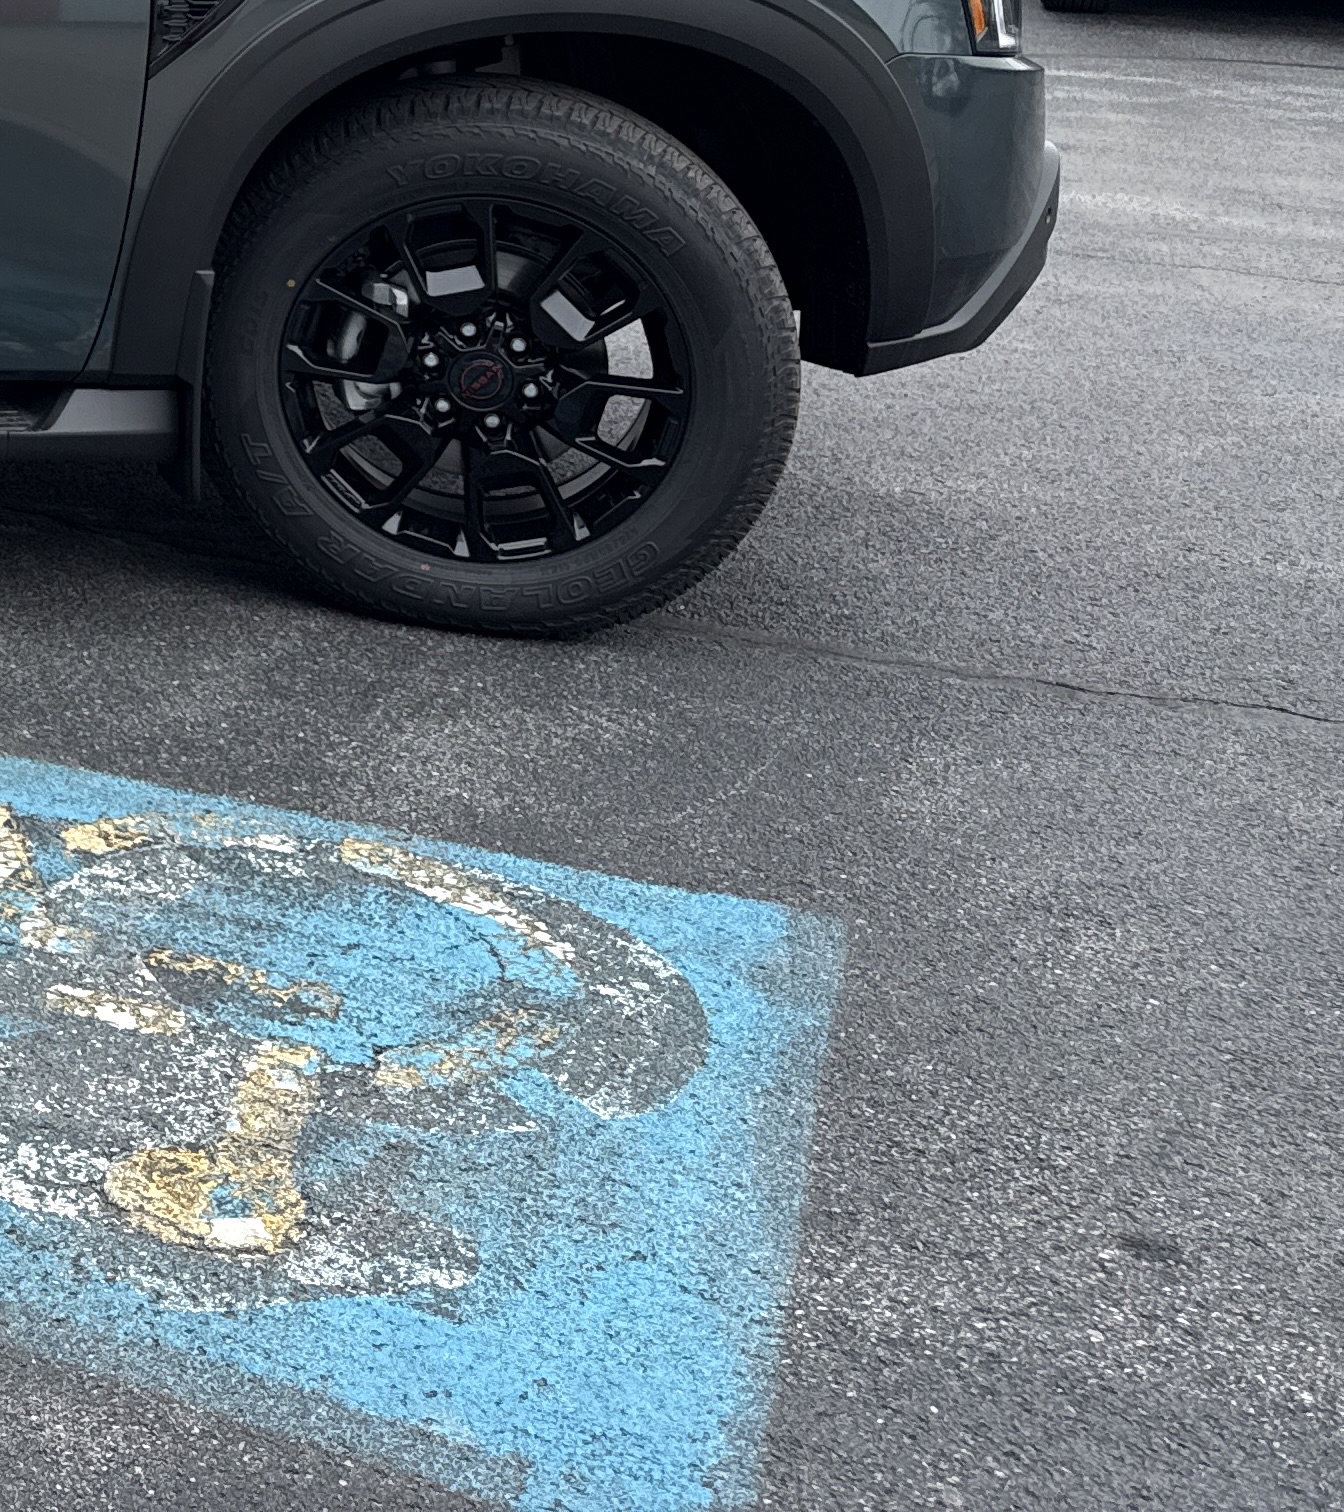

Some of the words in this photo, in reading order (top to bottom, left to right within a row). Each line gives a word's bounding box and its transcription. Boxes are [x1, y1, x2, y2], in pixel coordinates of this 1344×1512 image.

[386, 151, 687, 258] YOKOHAMA
[240, 432, 314, 519] A/T
[315, 531, 662, 612] GEOLANDAR
